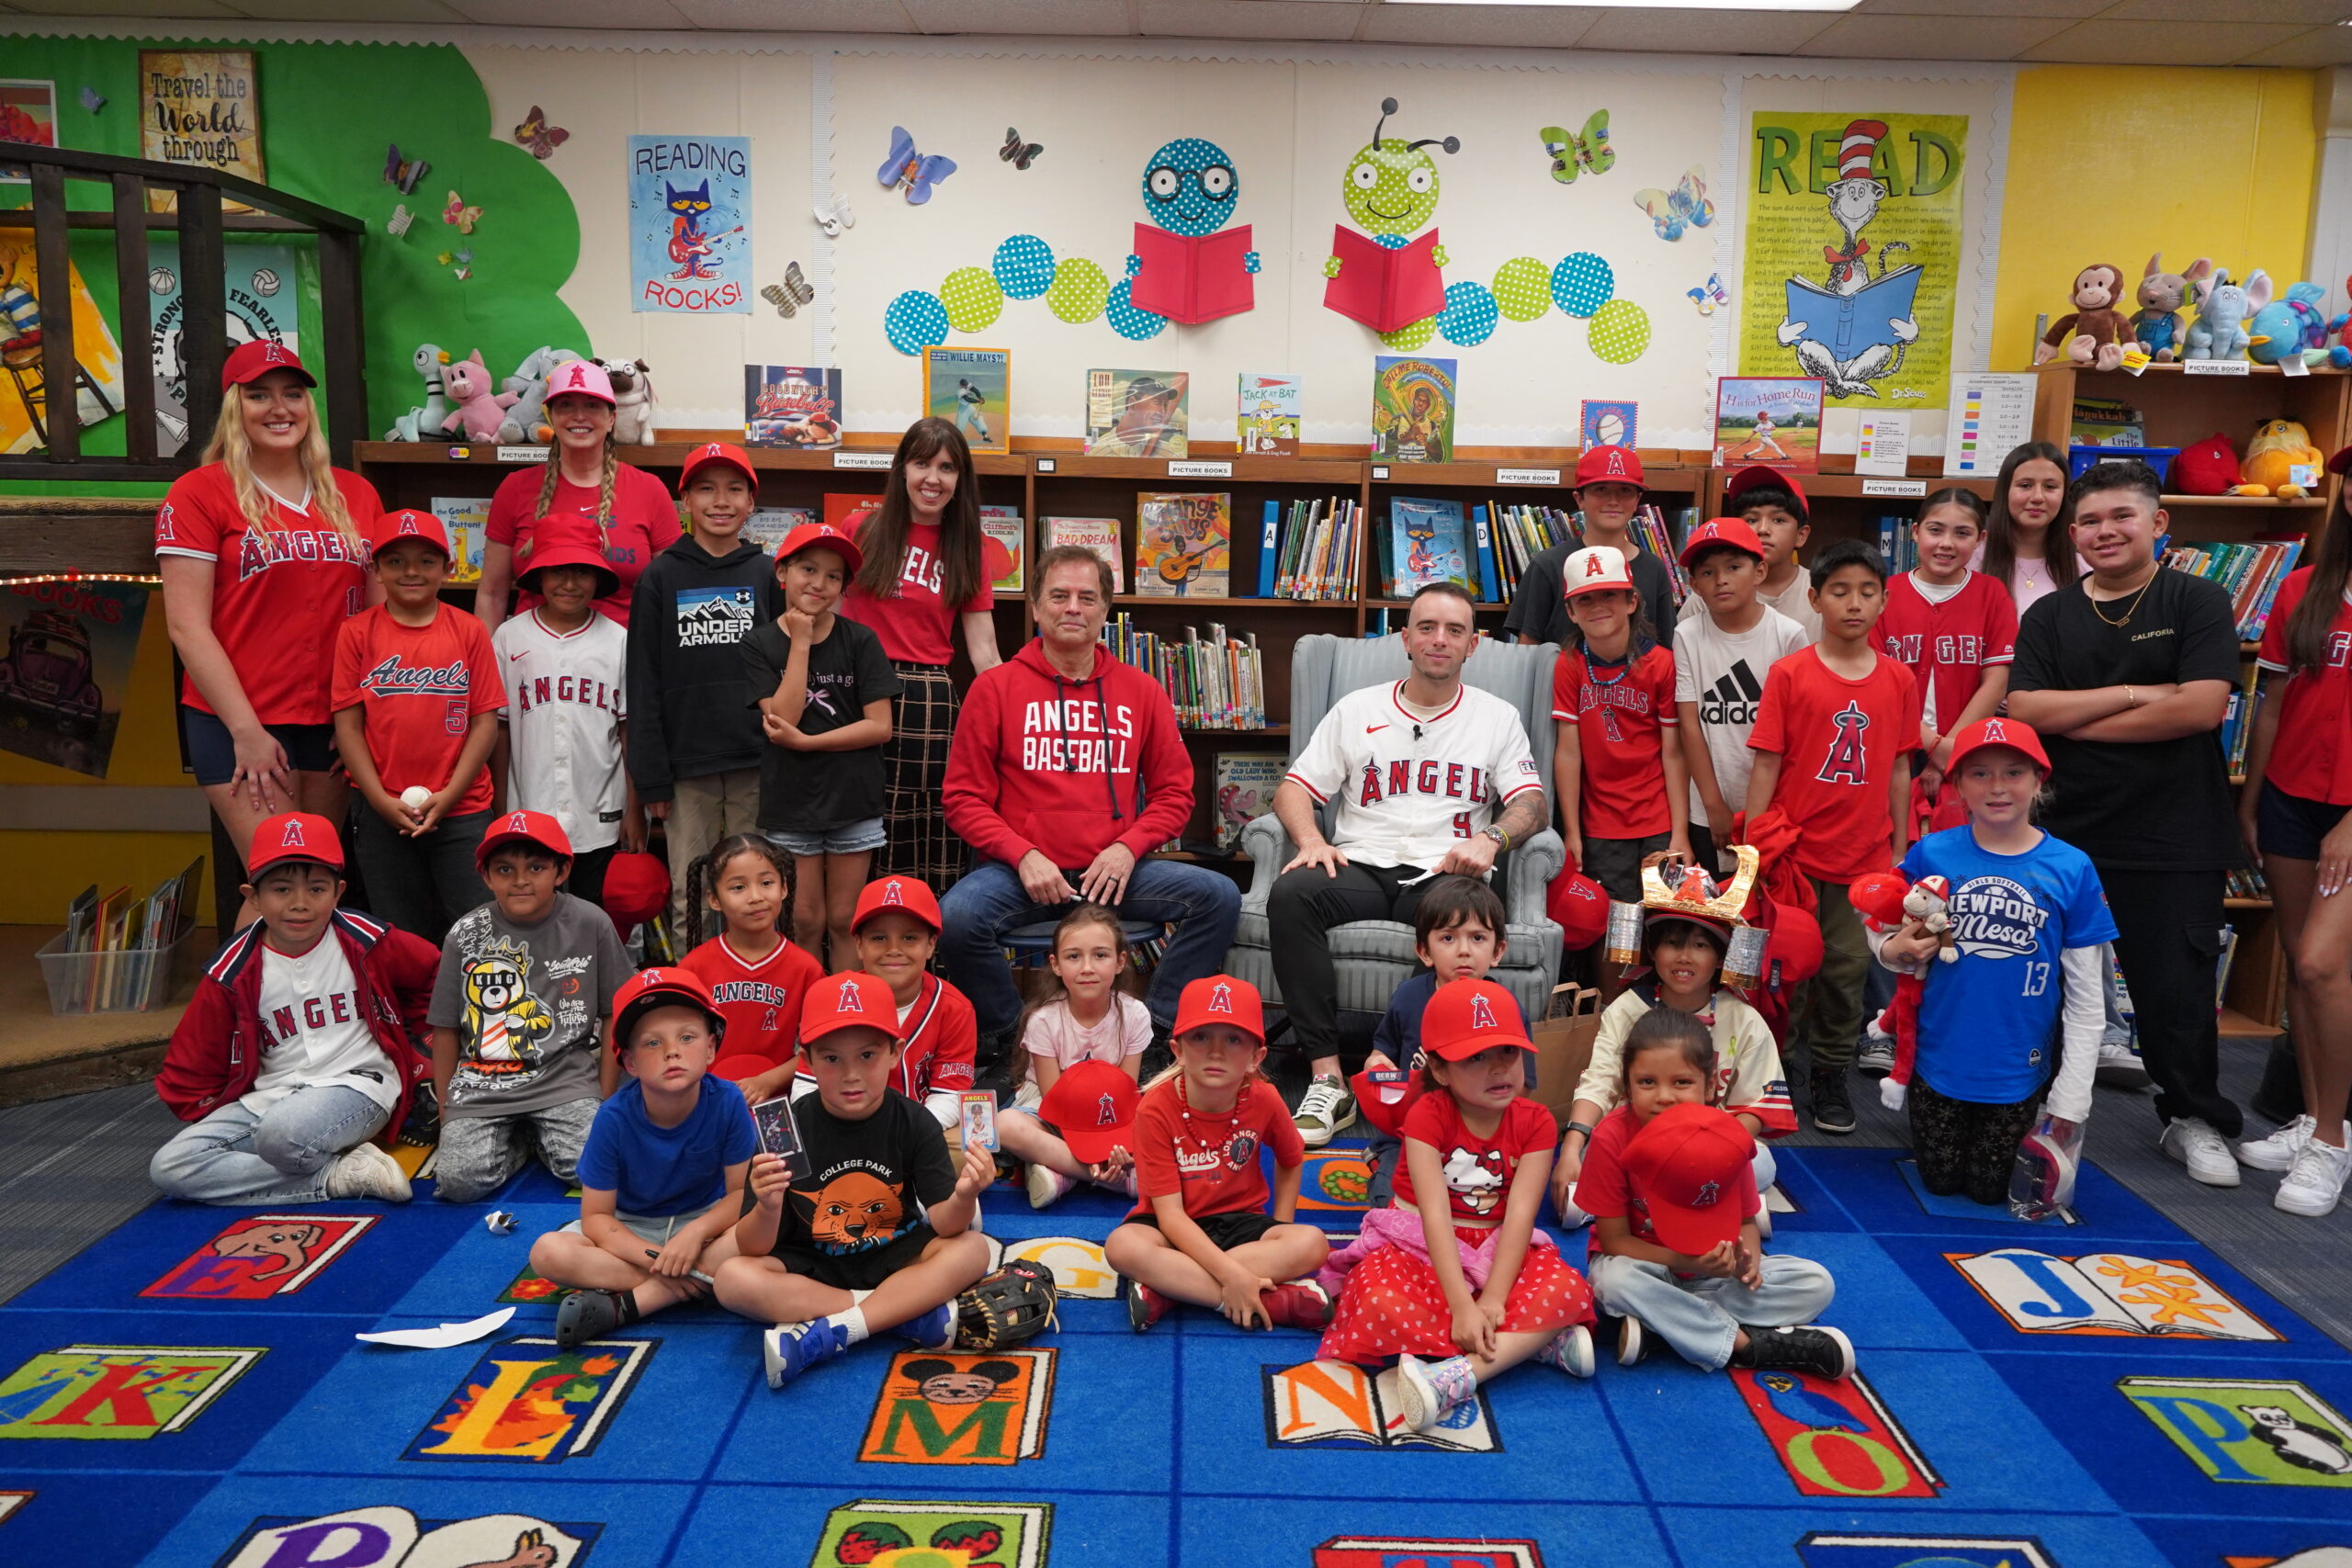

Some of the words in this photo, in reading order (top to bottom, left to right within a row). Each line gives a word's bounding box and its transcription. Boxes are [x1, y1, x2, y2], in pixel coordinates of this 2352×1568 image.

[152, 73, 210, 98] Travel
[216, 73, 246, 98] the
[154, 100, 244, 132] World
[163, 135, 240, 167] through
[636, 142, 746, 177] READING
[1756, 125, 1961, 198] READ
[645, 280, 742, 310] ROCKS!
[230, 288, 283, 345] FEARLES
[266, 342, 287, 364] A
[950, 353, 974, 362] WILLIE
[977, 355, 1003, 363] MAYS?!
[568, 366, 587, 388] A
[762, 383, 828, 396] GOODNIGHT
[752, 392, 834, 419] Baseball
[1243, 389, 1268, 400] JACK
[1279, 388, 1297, 399] BAT
[1725, 394, 1736, 406] H
[1745, 400, 1757, 408] for
[1758, 390, 1792, 405] Home
[1793, 388, 1815, 401] Run
[2111, 437, 2139, 448] Little
[1607, 450, 1626, 476] A
[399, 512, 419, 536] A
[1435, 503, 1456, 516] Cat
[448, 521, 481, 529] Button!
[1265, 529, 1273, 542] A
[1478, 529, 1487, 540] D
[240, 525, 375, 582] ANGELS
[1057, 535, 1079, 546] BAD
[1080, 535, 1117, 546] DREAM
[1883, 539, 1891, 551] M
[1584, 553, 1604, 577] A
[677, 619, 753, 637] UNDER
[679, 632, 745, 648] ARMOU
[1885, 634, 1987, 666] ANGE
[360, 654, 470, 695] Angels
[816, 671, 834, 684] just
[838, 674, 843, 683] a
[518, 677, 621, 717] ANGELS
[2227, 701, 2236, 715] T
[446, 700, 469, 734] 5
[1023, 700, 1133, 739] ANGELS
[1700, 701, 1759, 725] adida
[1815, 700, 1869, 785] A
[1984, 718, 2007, 742] A
[1023, 737, 1130, 773] BASEBALL
[1361, 752, 1490, 807] ANGELS
[281, 818, 306, 847] A
[507, 810, 528, 834] A
[1452, 810, 1472, 840] 9
[882, 879, 904, 906] A
[1966, 877, 1989, 889] GIRLS
[1992, 877, 2027, 897] SOFTBALL
[1947, 893, 2049, 930] NEWPORT
[1950, 914, 2031, 948] Mesa
[476, 974, 514, 985] KING
[2021, 961, 2051, 998] 13
[712, 981, 787, 1009] ANGELS
[838, 978, 864, 1012] A
[1208, 981, 1233, 1014] A
[258, 989, 367, 1054] ANGEL
[1472, 992, 1498, 1029] A
[1097, 1091, 1118, 1126] A
[1223, 1140, 1233, 1157] LOS
[1233, 1130, 1259, 1143] ANGEL
[819, 1157, 864, 1182] COLLEGE
[865, 1159, 893, 1179] PARK
[1989, 1252, 2095, 1318] J
[31, 1362, 201, 1430] K
[420, 1359, 575, 1459] L
[1278, 1364, 1374, 1436] N
[870, 1400, 1007, 1459] M
[2130, 1396, 2269, 1483] P
[1785, 1430, 1913, 1496] O
